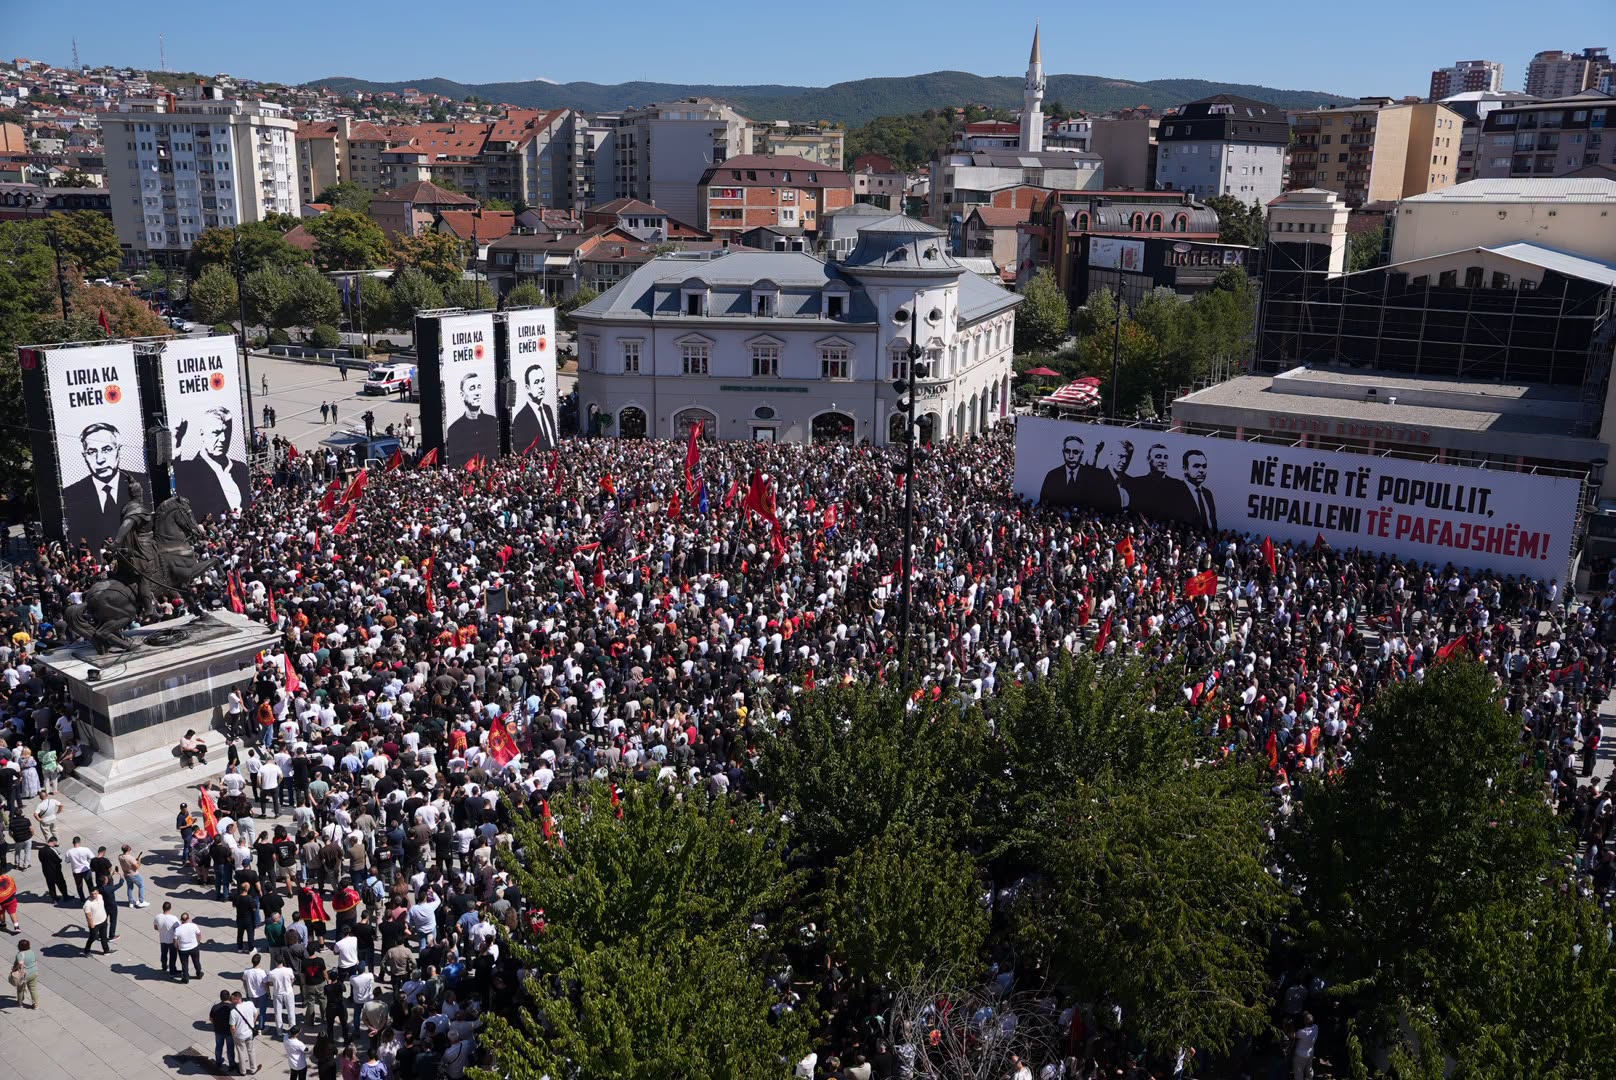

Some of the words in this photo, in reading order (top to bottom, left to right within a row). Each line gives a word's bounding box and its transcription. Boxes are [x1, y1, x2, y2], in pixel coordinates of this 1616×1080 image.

[1172, 249, 1244, 266] INTEREX
[452, 332, 472, 345] LIRIA
[473, 331, 483, 342] KA
[518, 325, 536, 338] LIRIA
[536, 324, 546, 335] KA
[453, 346, 474, 362] EMËR
[518, 339, 537, 354] EMËR
[176, 357, 207, 374] LIRIA
[208, 355, 223, 370] KA
[66, 368, 100, 386] LIRIA
[101, 366, 119, 382] KA
[179, 374, 209, 394] EMËR
[69, 387, 103, 408] EMËR
[1251, 456, 1279, 487] NË
[1280, 461, 1339, 496] EMËR
[1344, 466, 1371, 499] TË
[1377, 475, 1495, 518] POPULLIT,
[1248, 494, 1361, 534] SHPALLENI
[1367, 506, 1394, 538] TË
[1395, 514, 1551, 561] PAFAJSHËM!
